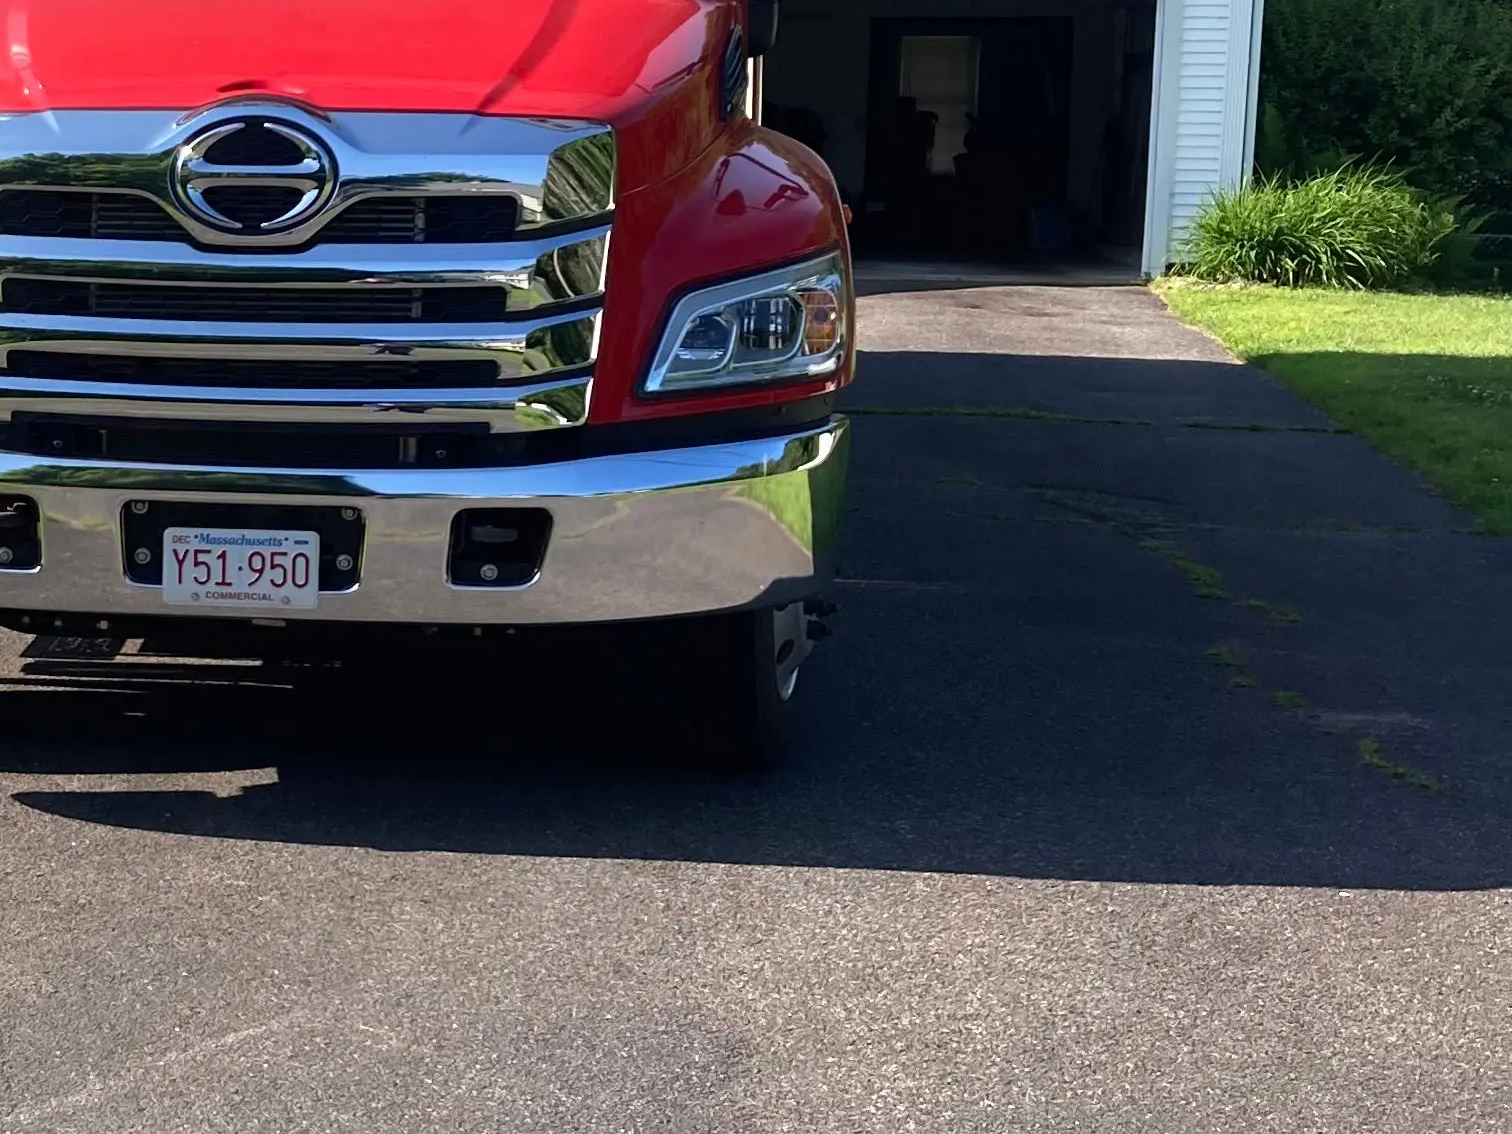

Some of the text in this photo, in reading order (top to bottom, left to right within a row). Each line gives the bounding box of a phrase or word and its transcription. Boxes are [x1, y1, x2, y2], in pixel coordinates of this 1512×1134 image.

[172, 533, 283, 547] DEC Massachusetts
[206, 591, 273, 601] COMMERCIAL
